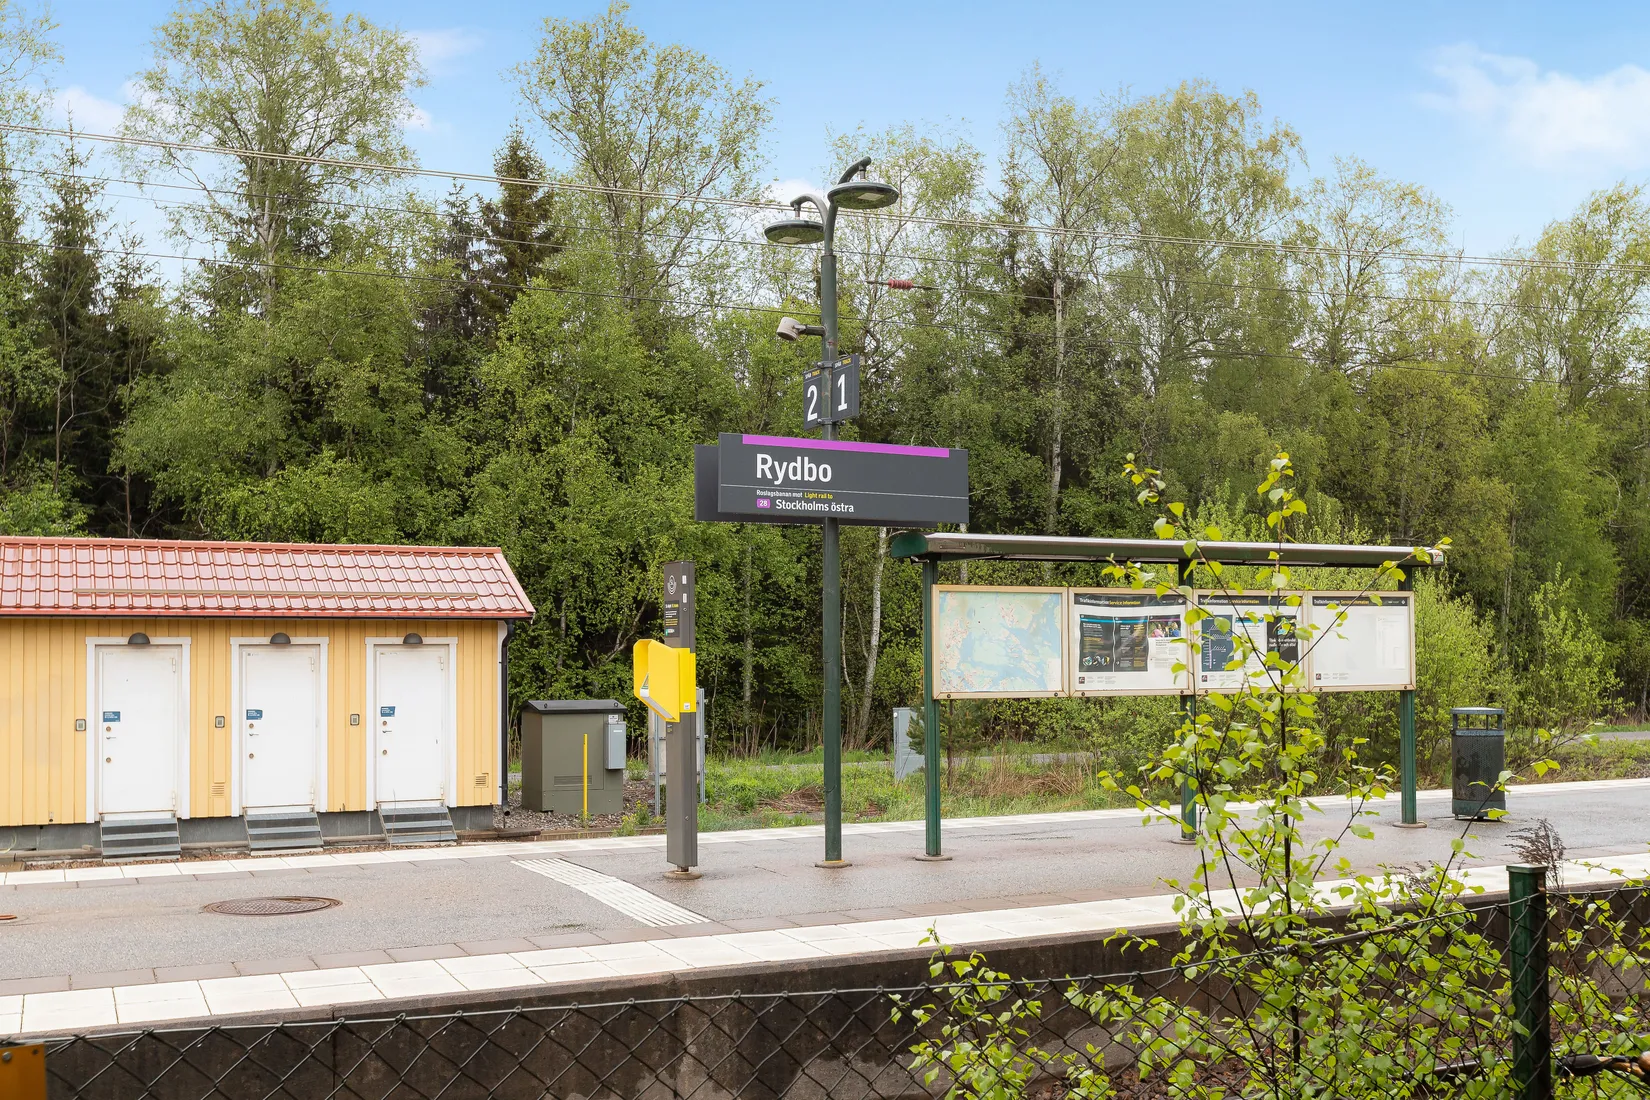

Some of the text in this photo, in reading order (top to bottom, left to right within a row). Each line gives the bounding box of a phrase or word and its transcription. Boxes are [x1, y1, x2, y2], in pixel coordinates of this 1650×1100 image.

[807, 384, 818, 422] 2
[837, 373, 848, 412] 1
[756, 453, 832, 485] Rydbo
[756, 489, 792, 498] Roslagsbanan
[775, 499, 829, 511] Stockholms
[830, 501, 855, 513] östra
